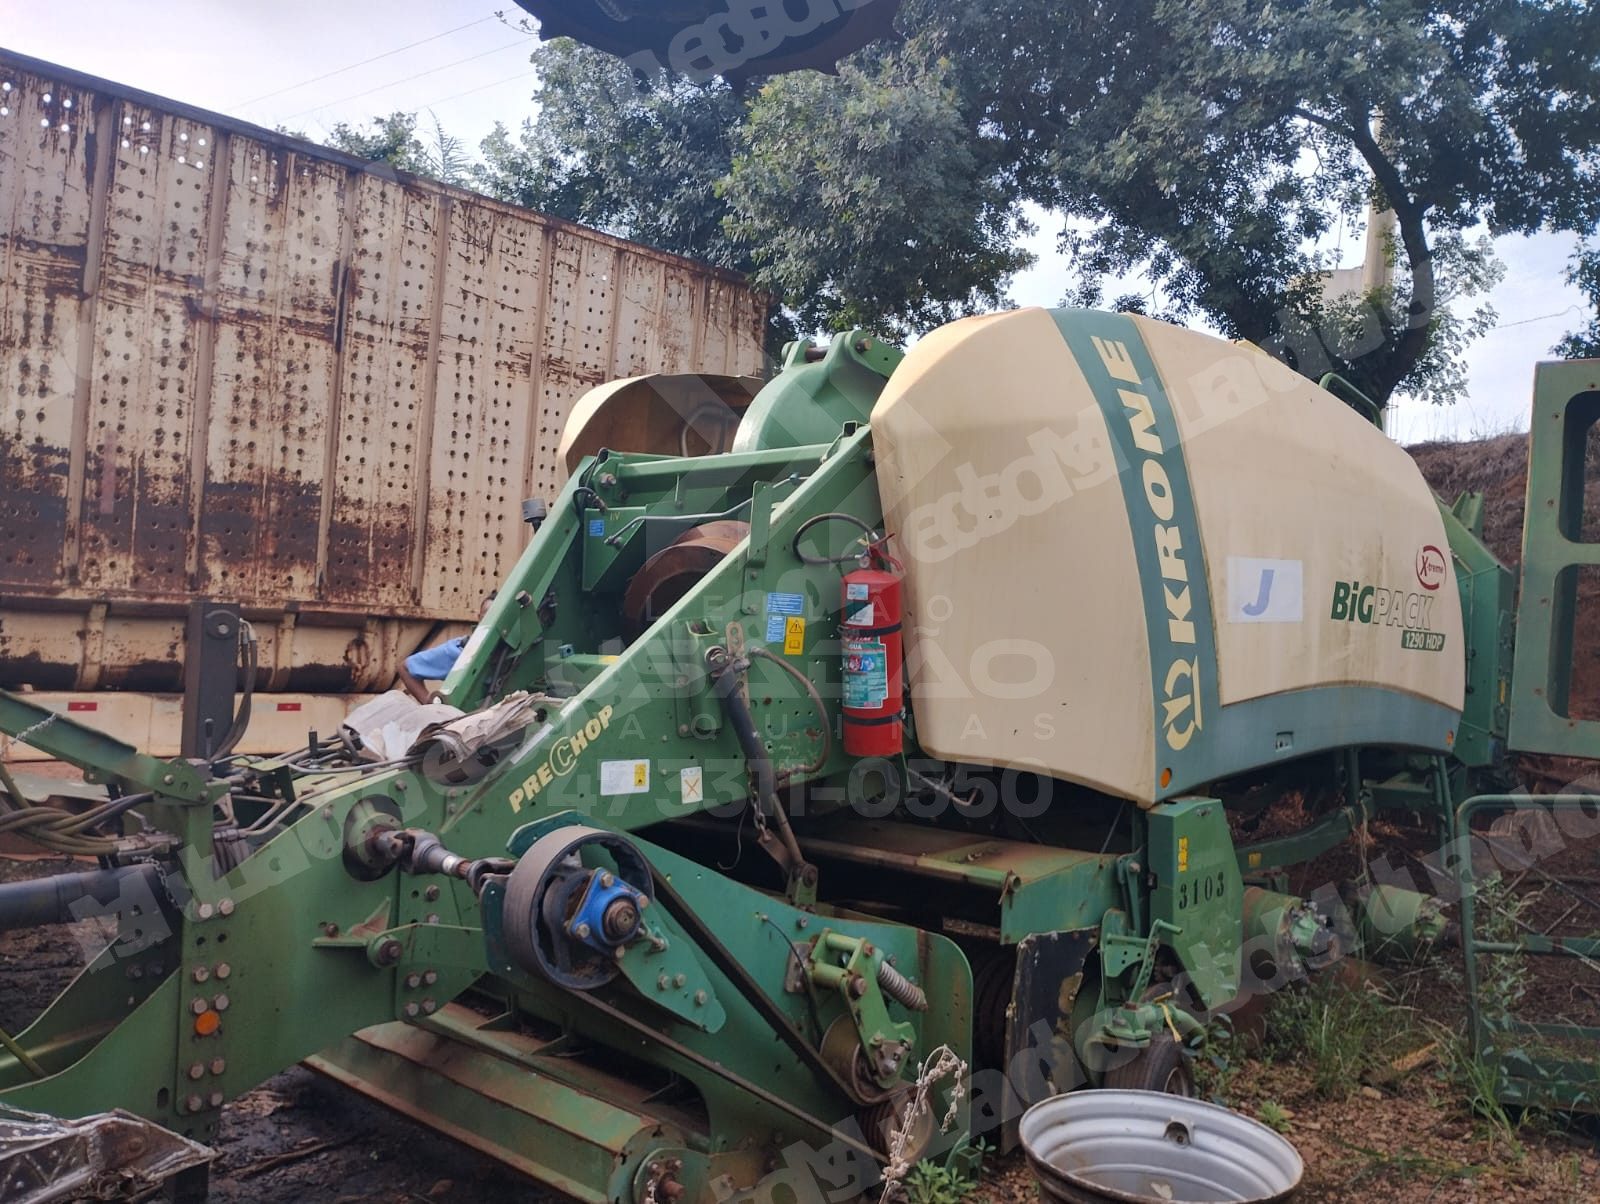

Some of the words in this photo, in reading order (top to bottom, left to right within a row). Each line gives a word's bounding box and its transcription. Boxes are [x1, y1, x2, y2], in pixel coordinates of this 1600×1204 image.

[1090, 335, 1197, 645] KRONE
[1241, 569, 1276, 617] J
[1425, 634, 1443, 650] HDP
[508, 704, 613, 814] PRECHOP
[1178, 871, 1225, 910] 3103
